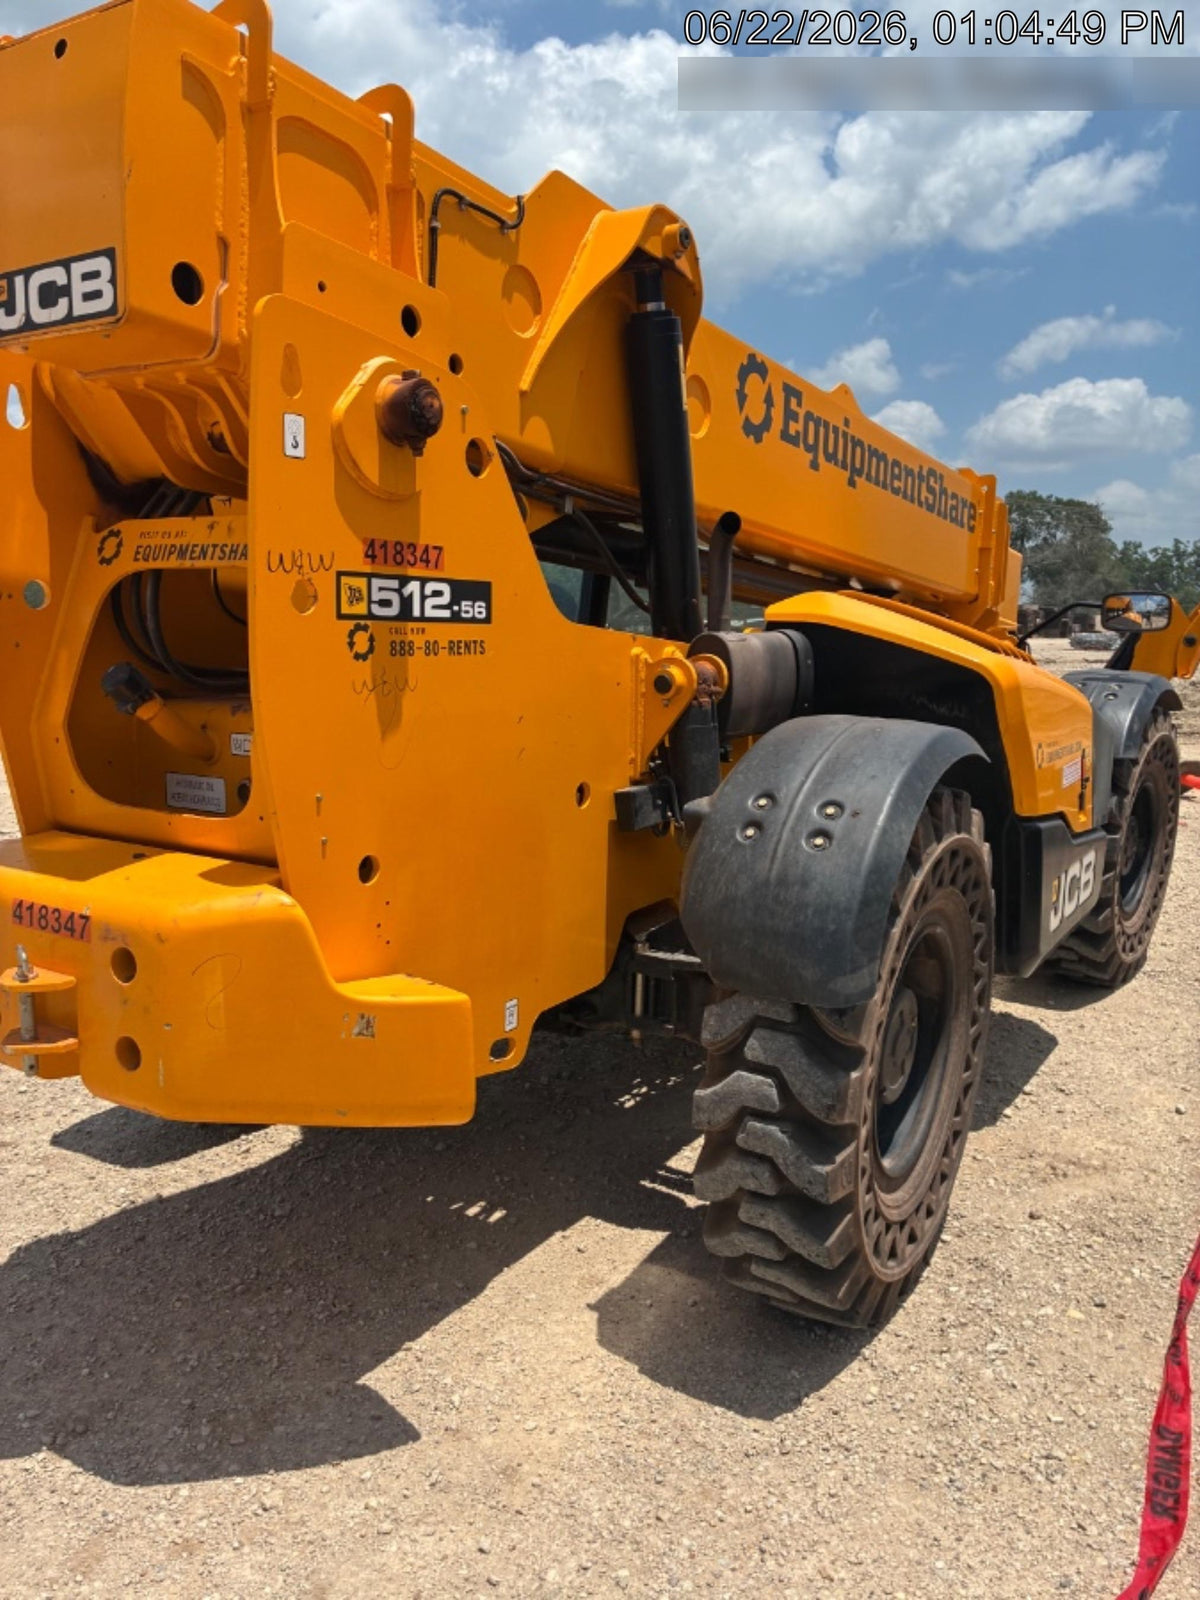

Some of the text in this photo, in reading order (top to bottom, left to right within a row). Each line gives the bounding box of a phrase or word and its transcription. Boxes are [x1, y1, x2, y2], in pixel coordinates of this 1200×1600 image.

[0, 255, 115, 330] JCB
[780, 380, 977, 533] EquipmentShare
[364, 539, 444, 569] 418347
[389, 639, 487, 657] 888-80-RENTS
[12, 898, 91, 940] 418347
[1049, 848, 1096, 933] JCB
